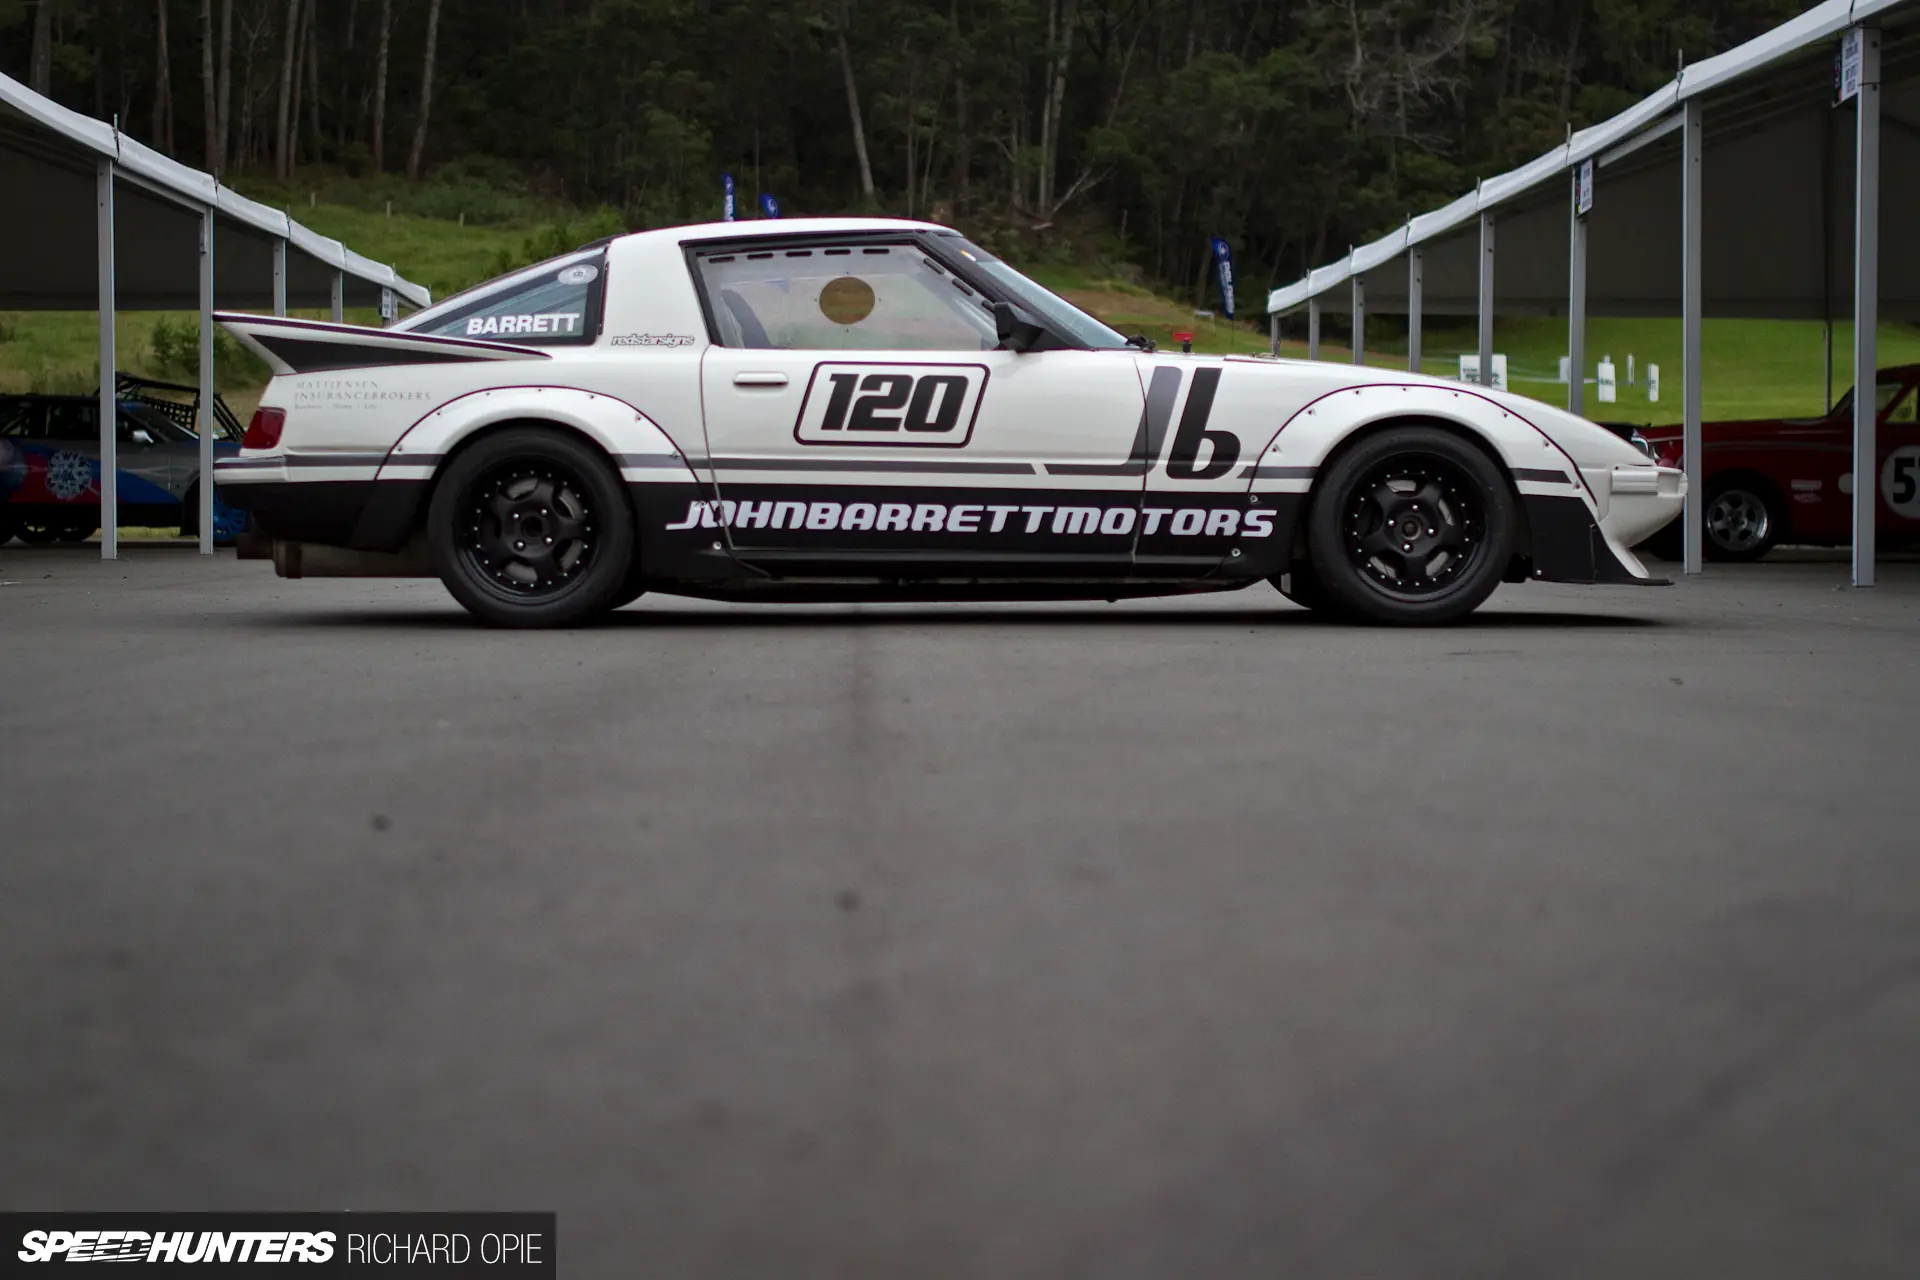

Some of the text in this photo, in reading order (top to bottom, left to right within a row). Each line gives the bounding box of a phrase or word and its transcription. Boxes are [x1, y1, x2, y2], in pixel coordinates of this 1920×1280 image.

[466, 313, 580, 335] BARRETT
[611, 333, 695, 348] redstarsigns
[820, 373, 969, 433] 120
[1893, 456, 1920, 504] 5
